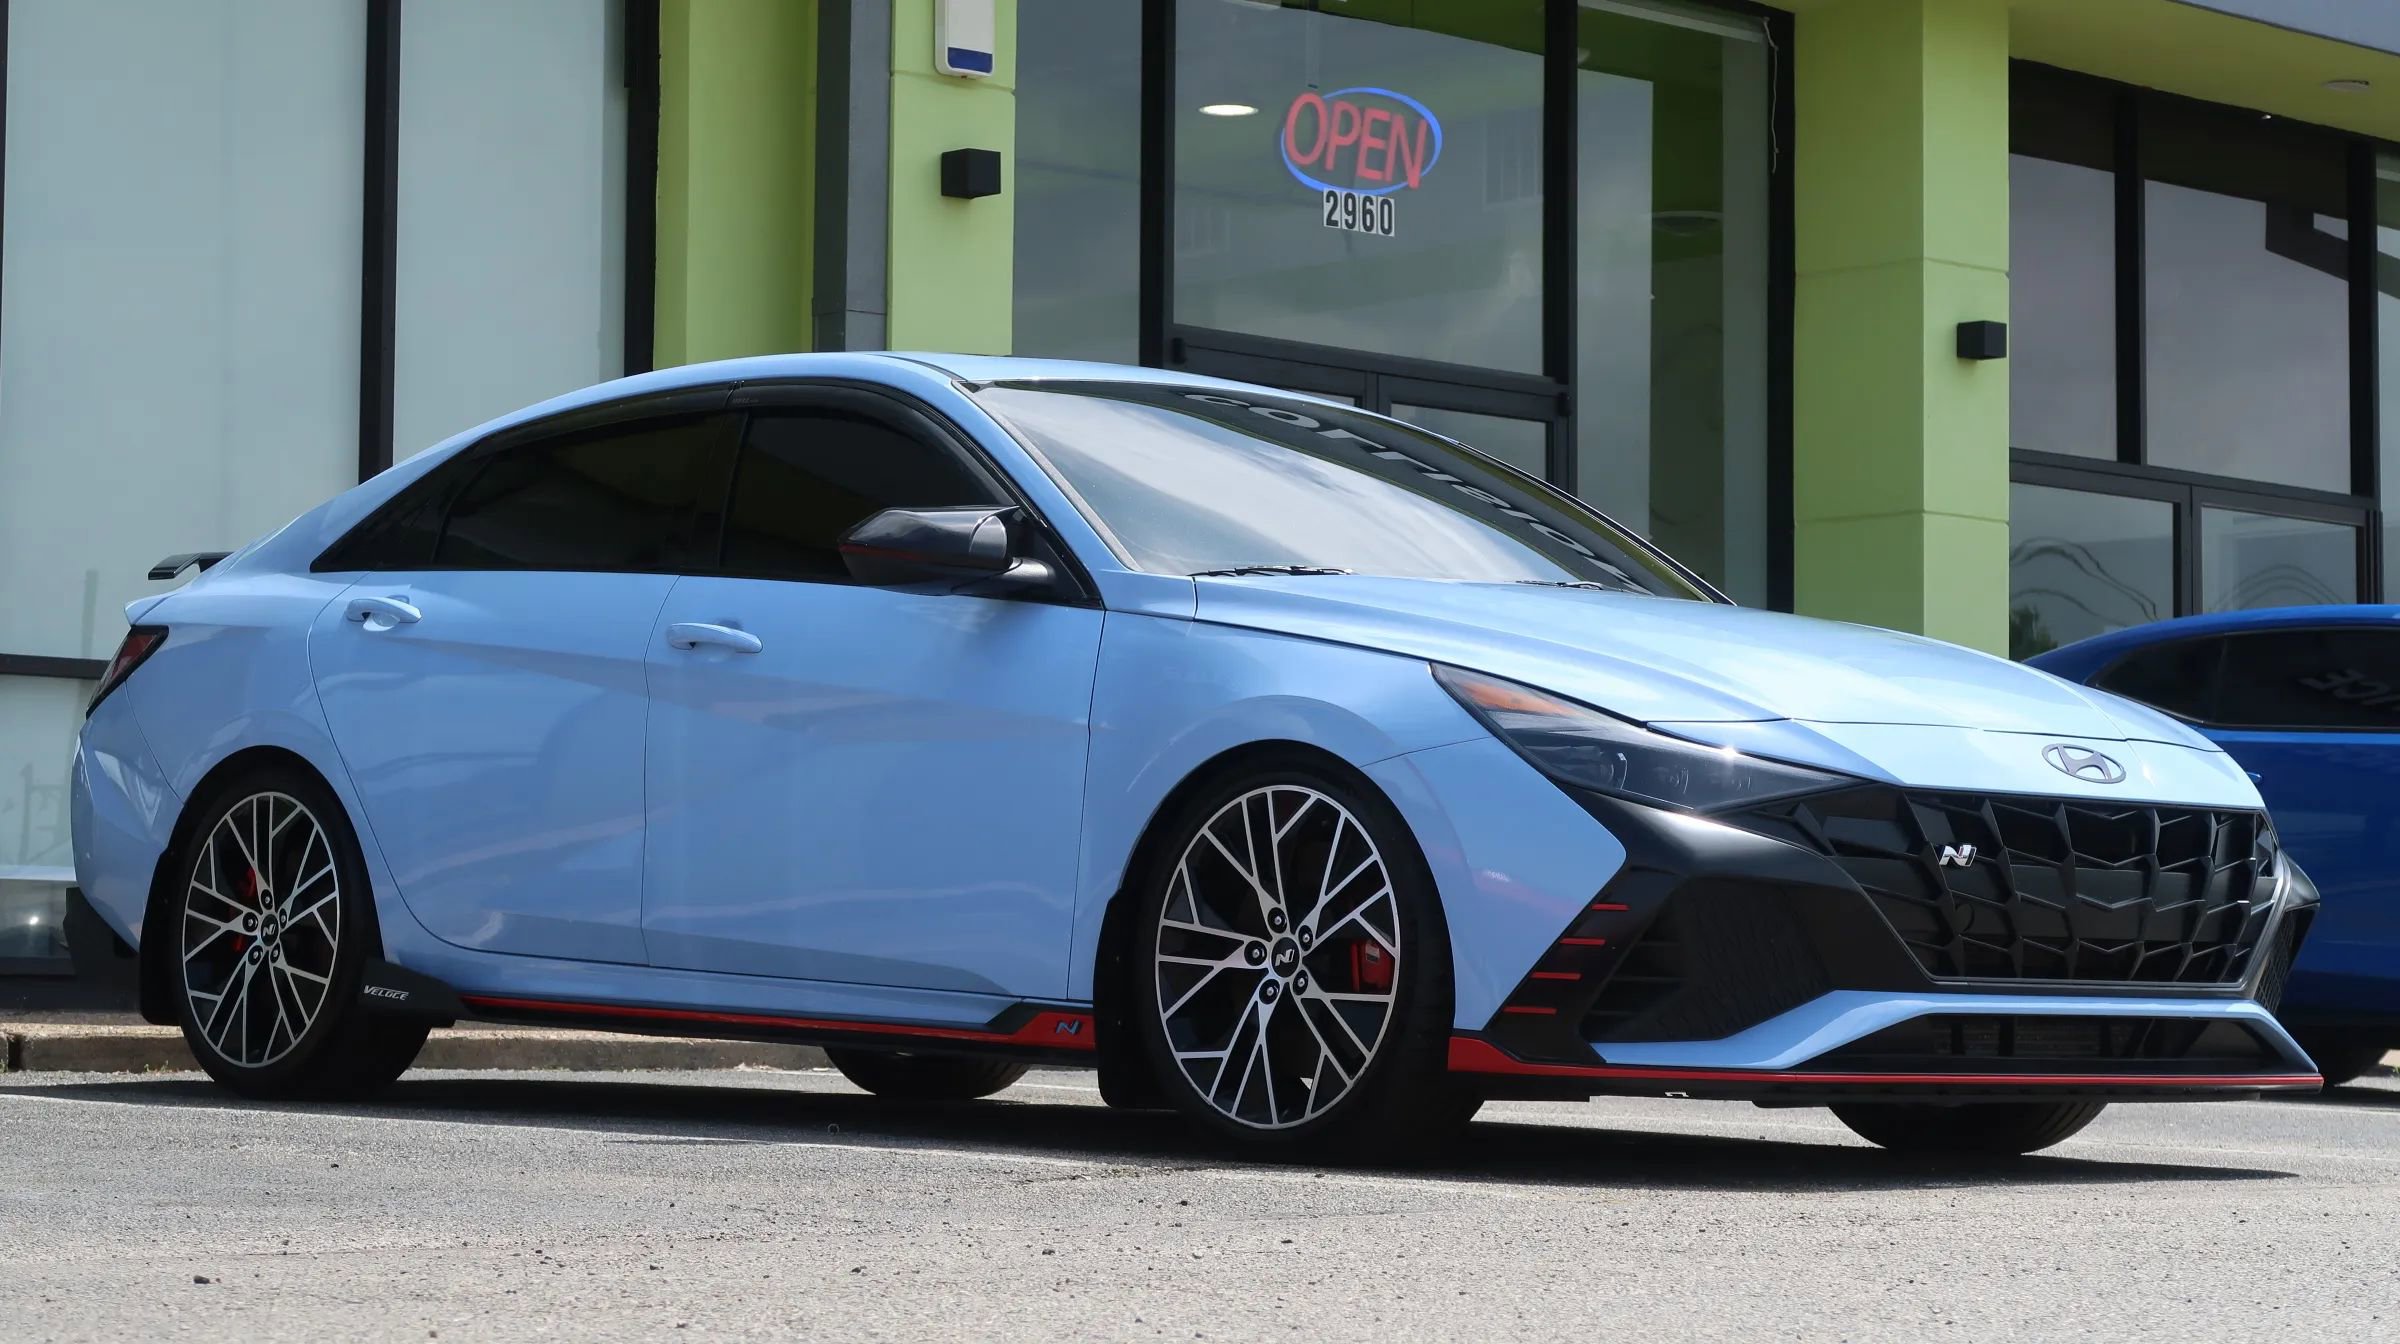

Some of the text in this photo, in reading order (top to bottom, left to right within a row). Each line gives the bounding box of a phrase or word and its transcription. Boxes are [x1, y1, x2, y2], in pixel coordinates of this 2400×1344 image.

[1285, 92, 1428, 189] OPEN
[1325, 190, 1393, 236] 2960
[1938, 844, 1977, 867] N
[363, 985, 410, 1001] VELOCE
